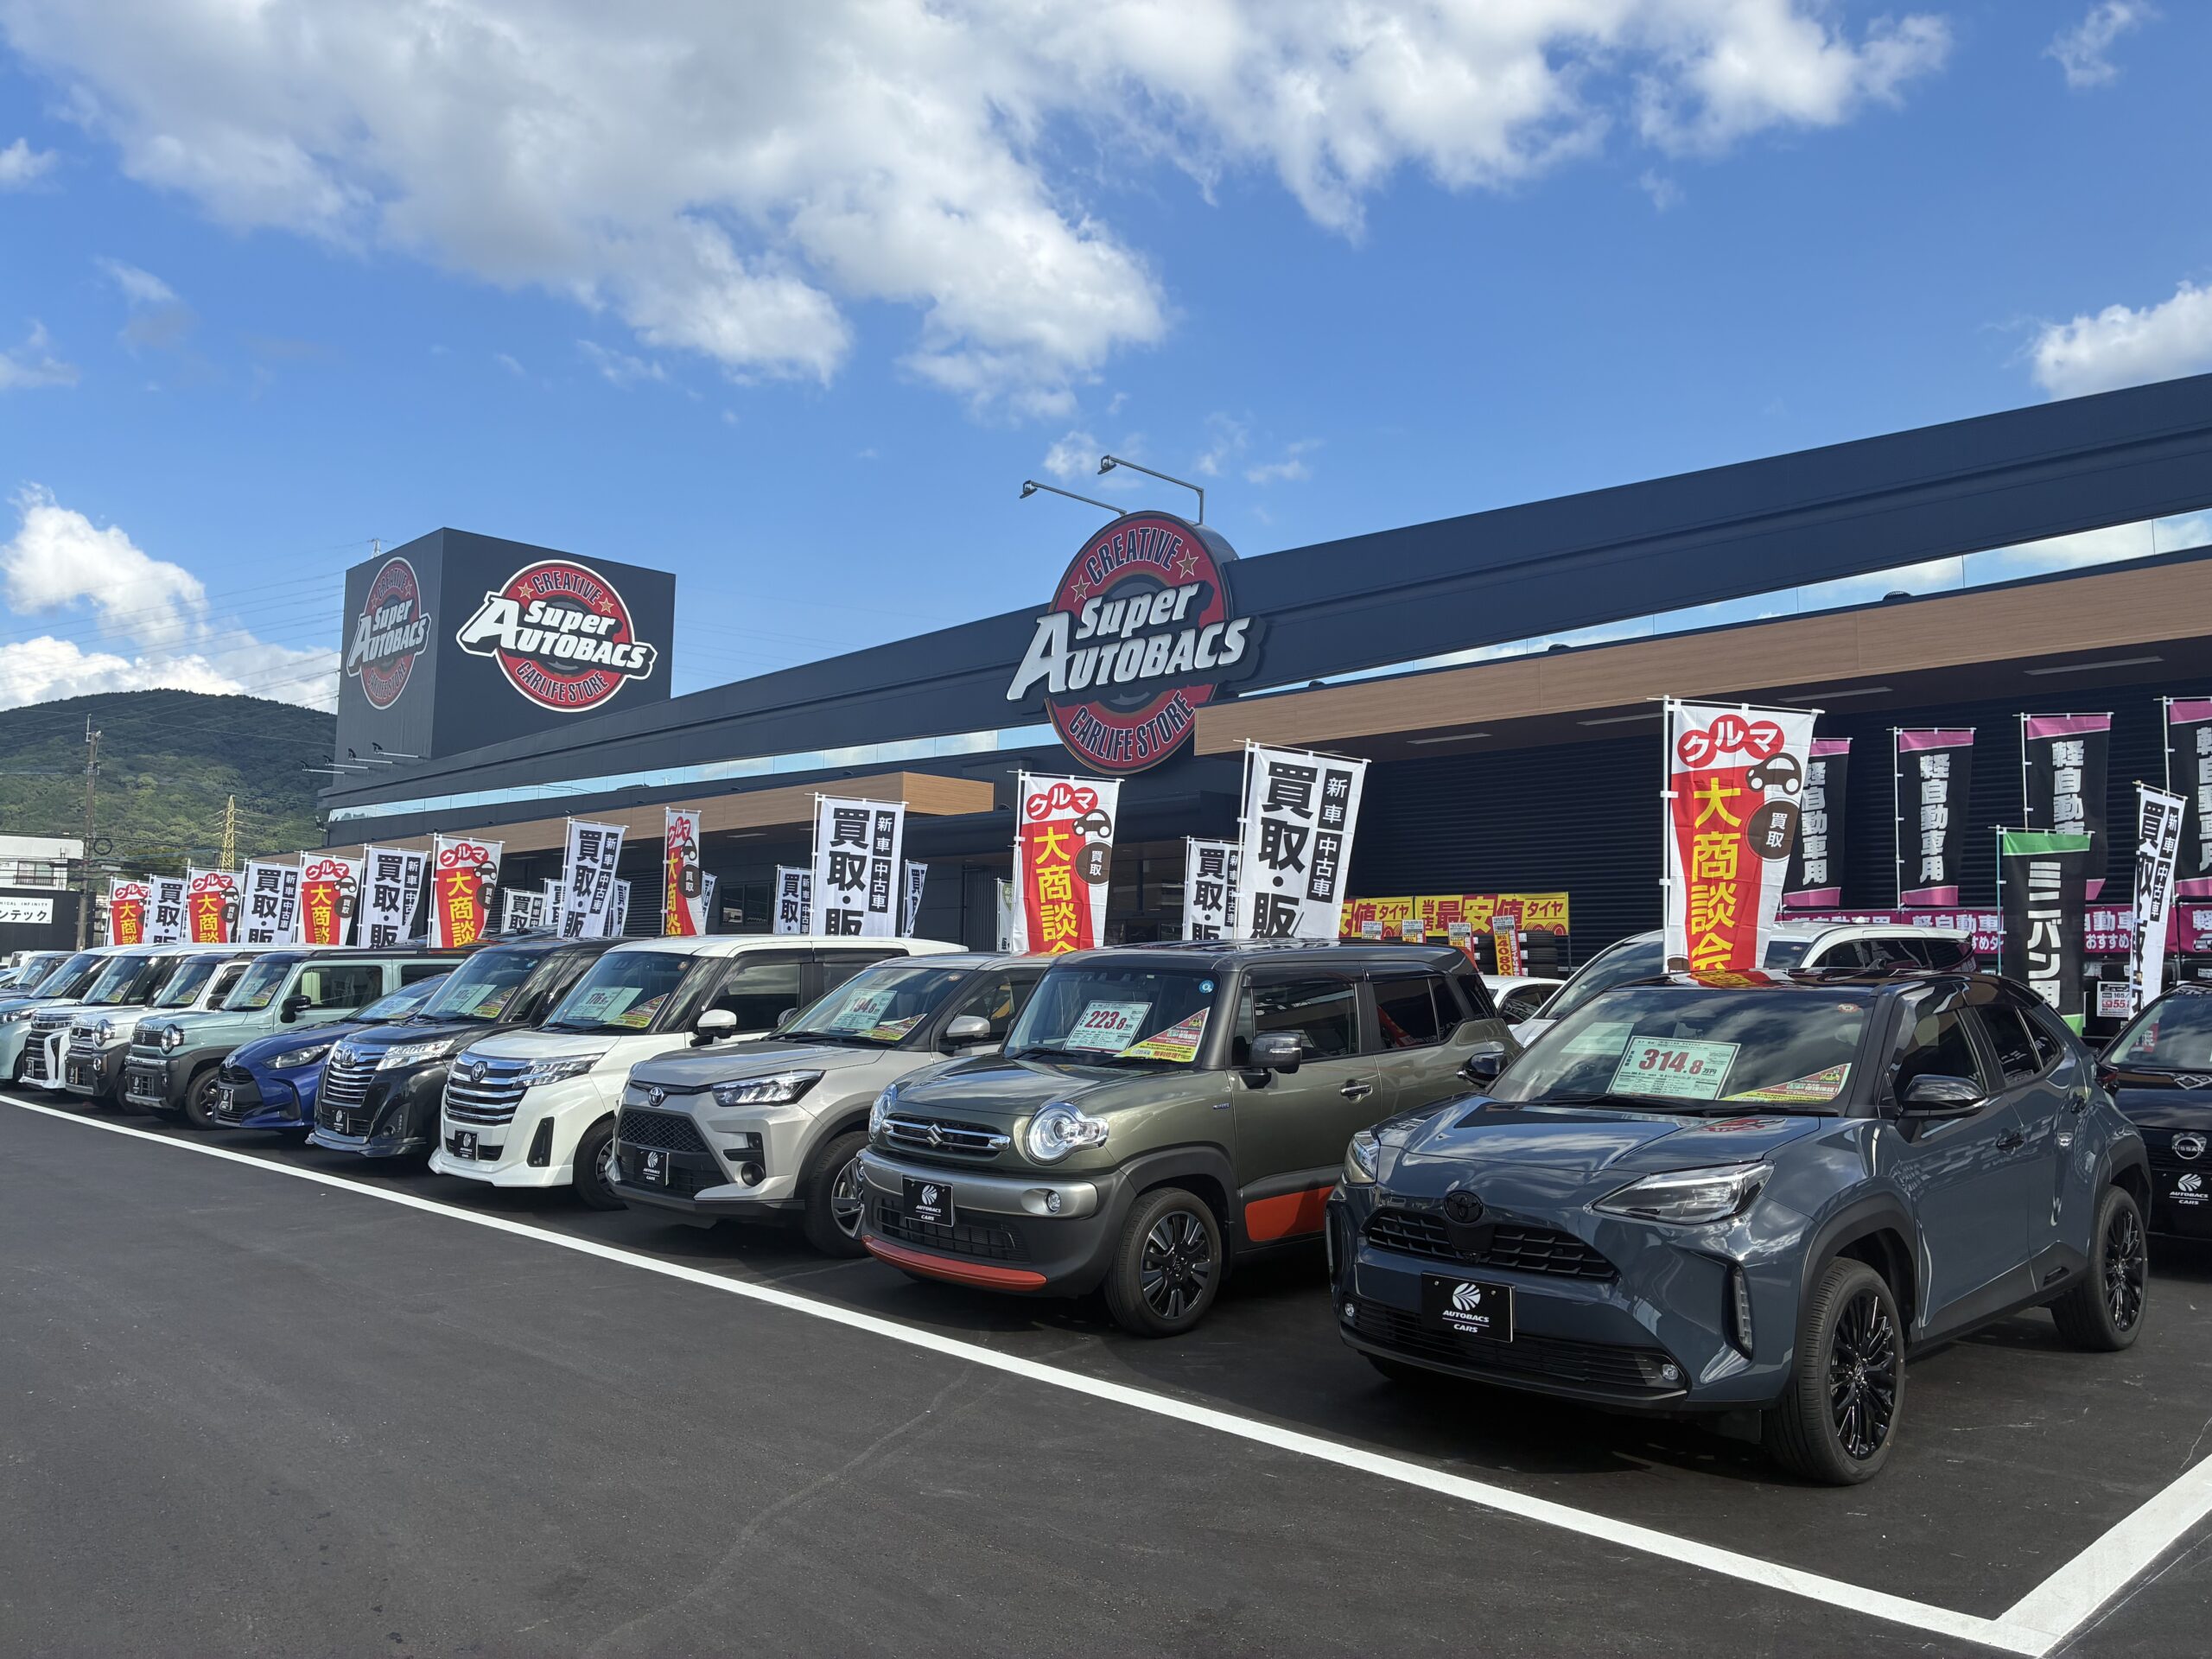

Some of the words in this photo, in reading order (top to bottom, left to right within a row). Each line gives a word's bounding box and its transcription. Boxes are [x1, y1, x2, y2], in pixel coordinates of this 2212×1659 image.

[1084, 527, 1183, 586] CREATIVE
[377, 569, 407, 598] CREATIVE
[531, 571, 602, 605] CREATIVE
[372, 599, 414, 630] Super
[524, 600, 616, 636] Super
[1075, 582, 1200, 639] Super
[348, 613, 427, 668] AUTOBACS
[461, 596, 648, 670] AUTOBACS
[1006, 610, 1252, 701] AUTOBACS
[368, 668, 389, 698] CARLIFE
[388, 658, 408, 696] STORE
[515, 661, 567, 702] CARLIFE
[568, 671, 609, 702] STORE
[1068, 706, 1133, 762] CARLIFE
[1135, 690, 1197, 759] STORE
[1683, 721, 1779, 763] クルマ
[1030, 787, 1095, 817] クルマ
[1323, 777, 1348, 823] 新車
[1919, 753, 1950, 884] 軽自動車用
[668, 819, 690, 846] クルマ
[875, 816, 893, 853] 新車
[1766, 812, 1789, 849] 買取
[1802, 761, 1828, 886] 軽自動車用
[2162, 812, 2178, 854] 新車
[442, 846, 486, 866] クルマ
[603, 836, 618, 867] 新車
[1089, 849, 1103, 876] 買取
[1250, 760, 1319, 939] 買取・販
[1311, 836, 1338, 898] 中古車
[194, 874, 231, 890] クルマ
[308, 861, 348, 879] クルマ
[406, 861, 419, 886] 新車
[871, 861, 889, 910] 中古車
[1691, 777, 1743, 971] 大商談会
[117, 884, 149, 899] クルマ
[447, 871, 475, 948] 大商談
[592, 874, 610, 912] 中古車
[1527, 900, 1565, 918] タイヤ
[2151, 864, 2169, 918] 中古車
[0, 910, 47, 922] ンテック
[310, 883, 333, 945] 大商談
[1379, 905, 1409, 921] タイヤ
[1912, 914, 2004, 935] 軽自動車
[2027, 861, 2063, 1009] ミニバン用
[2086, 933, 2130, 950] おすすめ
[1084, 1010, 1127, 1030] 223.8
[1638, 1048, 1704, 1075] 314.8
[916, 1205, 941, 1213] AUTOBACS
[1442, 1309, 1490, 1323] AUTOBACS
[1453, 1323, 1478, 1333] CARS
